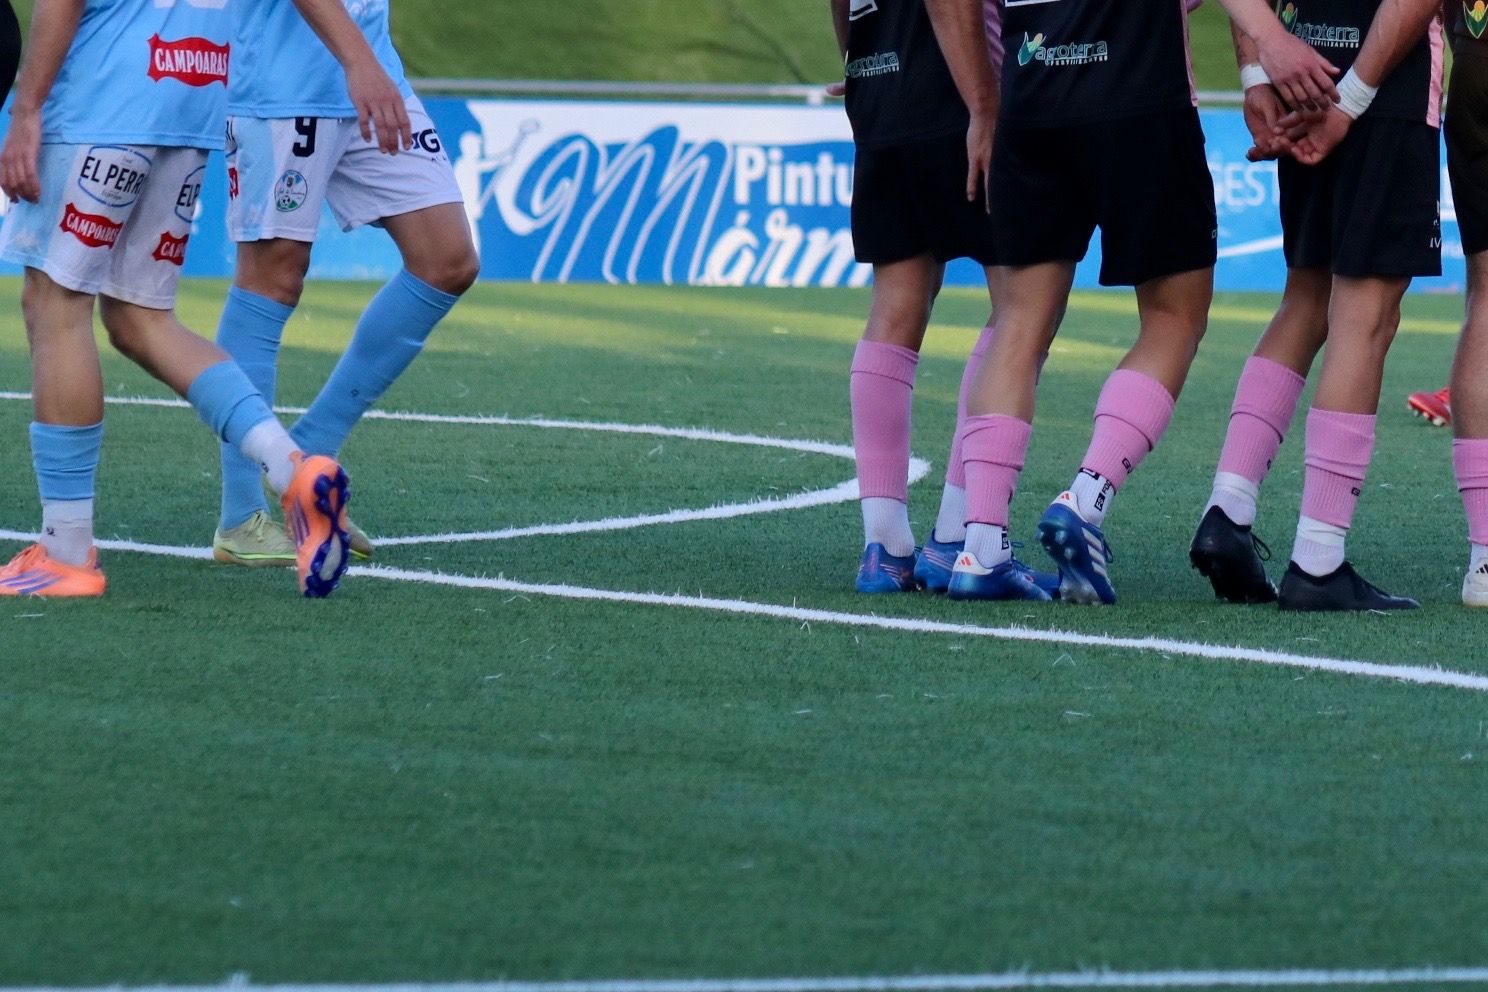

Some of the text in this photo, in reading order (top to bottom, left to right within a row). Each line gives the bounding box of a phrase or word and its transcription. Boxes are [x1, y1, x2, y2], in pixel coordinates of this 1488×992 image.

[154, 47, 228, 76] CAMPOARAS
[292, 117, 317, 157] 9
[80, 155, 102, 183] EL
